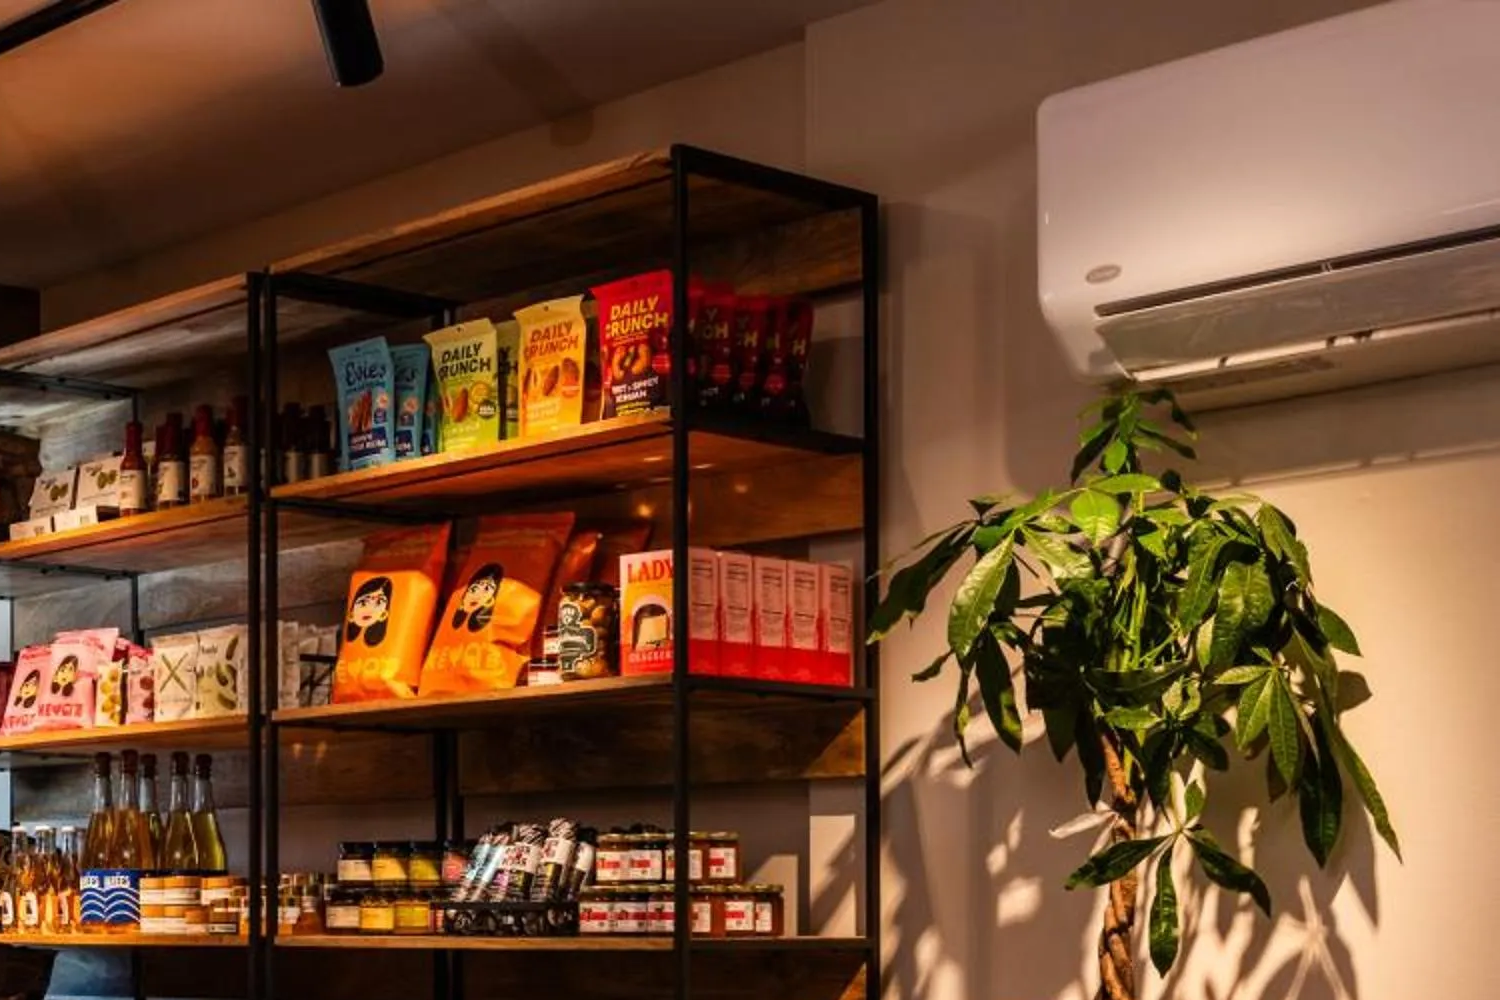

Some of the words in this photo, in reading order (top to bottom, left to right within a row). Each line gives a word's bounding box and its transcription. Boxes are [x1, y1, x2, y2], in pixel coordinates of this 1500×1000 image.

[611, 294, 659, 320] DAILY
[530, 321, 573, 342] DAILY
[442, 342, 483, 363] DAILY
[627, 558, 673, 583] LADY
